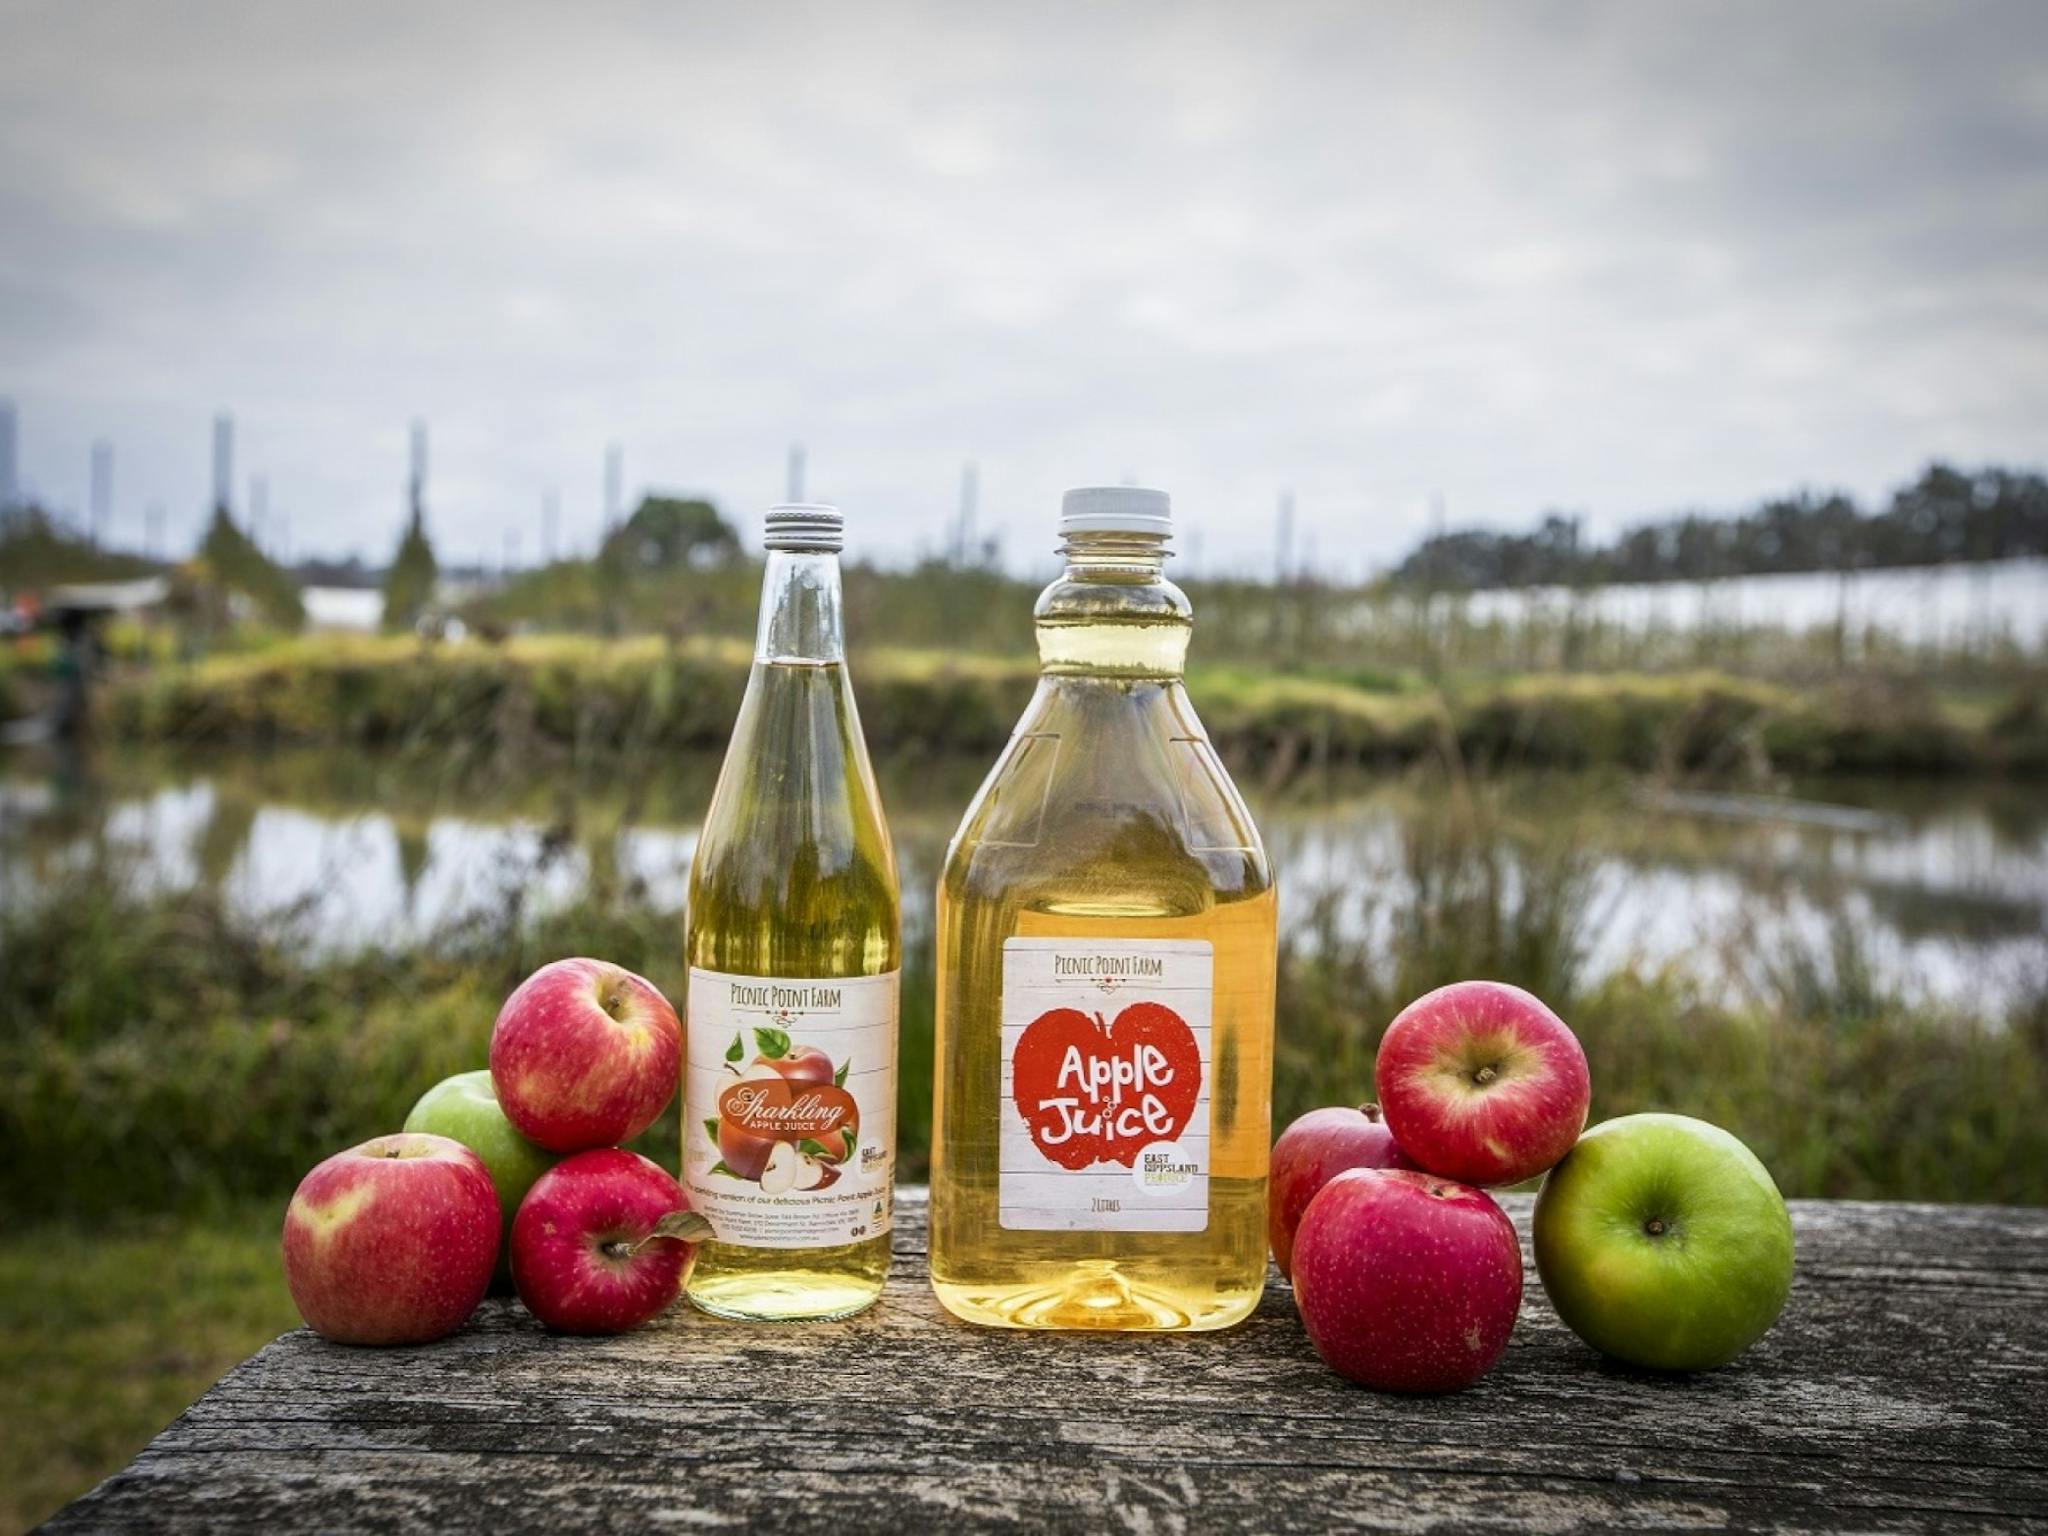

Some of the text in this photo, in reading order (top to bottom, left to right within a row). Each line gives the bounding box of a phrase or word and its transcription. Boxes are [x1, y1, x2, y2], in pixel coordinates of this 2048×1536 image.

[1054, 954, 1163, 977] PICNIC POINT FARM
[731, 982, 842, 1009] PICNIC POINT FARM
[1056, 1043, 1175, 1104] Apple
[726, 1087, 846, 1130] Sparkling
[1039, 1093, 1175, 1145] Juice
[750, 1120, 817, 1132] APPLE JUICE
[1144, 1153, 1170, 1164] EAST
[1144, 1163, 1199, 1174] GIPPSLAND
